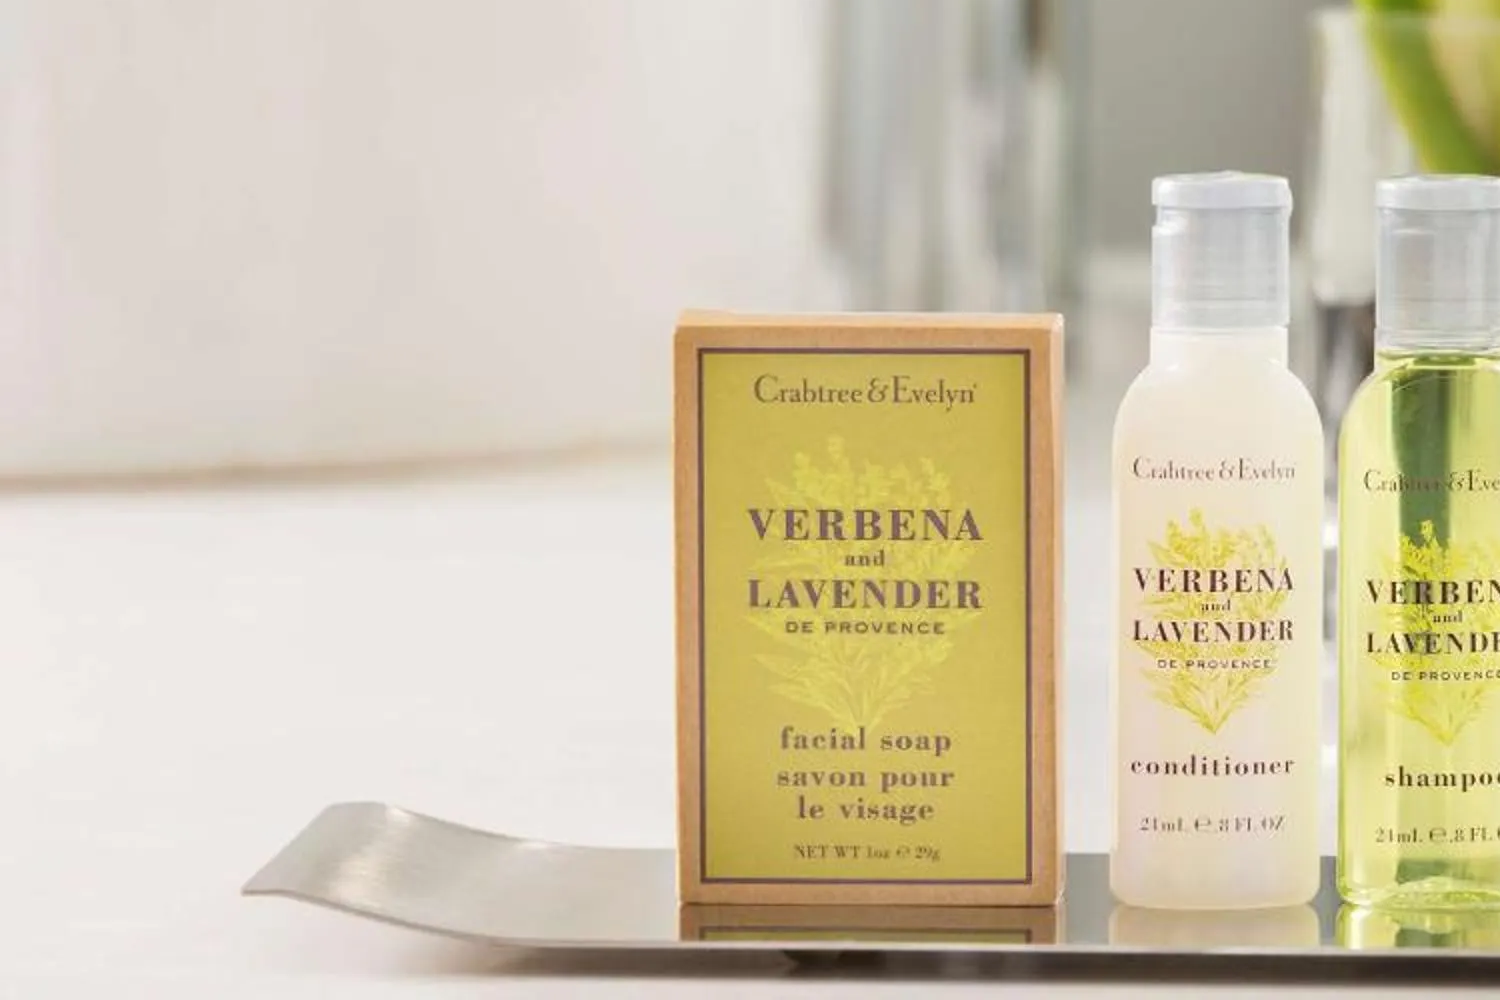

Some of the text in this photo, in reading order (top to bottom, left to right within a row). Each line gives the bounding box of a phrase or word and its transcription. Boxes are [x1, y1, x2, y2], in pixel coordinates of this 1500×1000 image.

[867, 377, 889, 404] &
[1219, 459, 1234, 480] &
[1448, 472, 1466, 491] &
[748, 509, 982, 541] VERBENA
[844, 549, 885, 568] and
[1133, 568, 1294, 593] VERBENA
[748, 579, 982, 609] LAVENDER
[1201, 600, 1231, 612] and
[1432, 610, 1463, 624] and
[785, 621, 944, 634] DE PROVENCE
[1133, 620, 1294, 643] LAVENDER
[1157, 659, 1271, 669] DE PROVENCE
[1392, 672, 1411, 680] DE
[780, 727, 951, 755] facial soap
[1131, 756, 1295, 776] conditioner
[776, 768, 954, 791] savon pour
[796, 796, 934, 824] le visage
[794, 844, 827, 859] NET
[834, 844, 861, 859] WT
